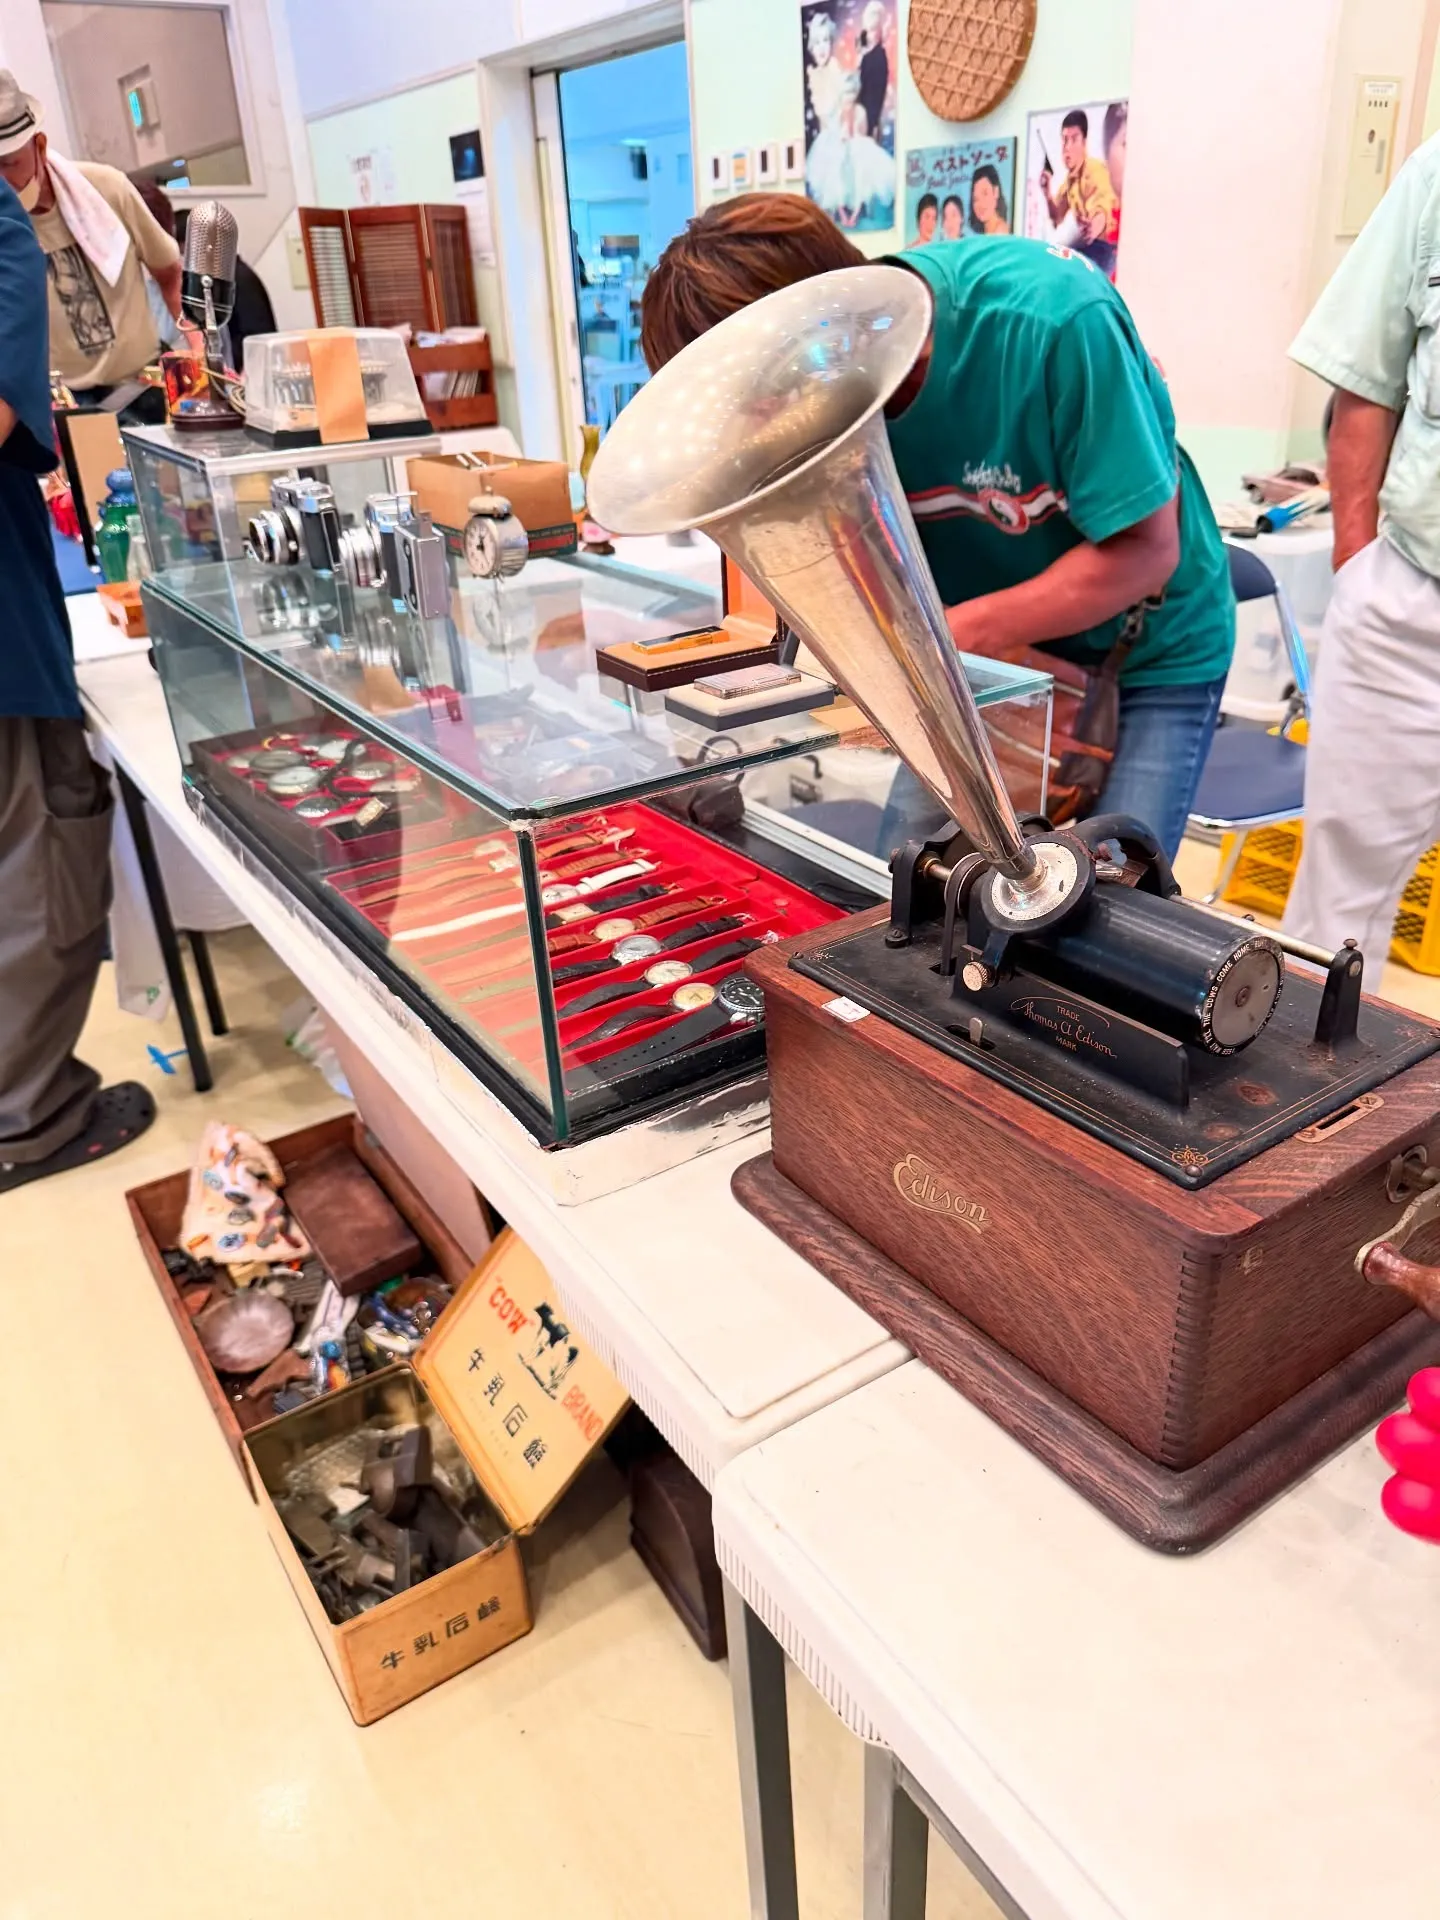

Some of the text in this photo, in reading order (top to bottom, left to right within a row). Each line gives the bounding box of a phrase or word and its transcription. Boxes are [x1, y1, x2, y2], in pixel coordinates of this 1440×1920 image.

[1232, 943, 1251, 962] HOME
[1216, 960, 1234, 982] COME
[1206, 985, 1219, 1009] COWS
[1056, 1004, 1081, 1023] TRADE
[1202, 1012, 1212, 1028] THE
[1010, 1000, 1059, 1031] Thomas
[1074, 1024, 1118, 1060] Edison
[1055, 1035, 1078, 1052] MARK
[893, 1152, 990, 1235] Edison
[560, 1384, 605, 1442] BRAND
